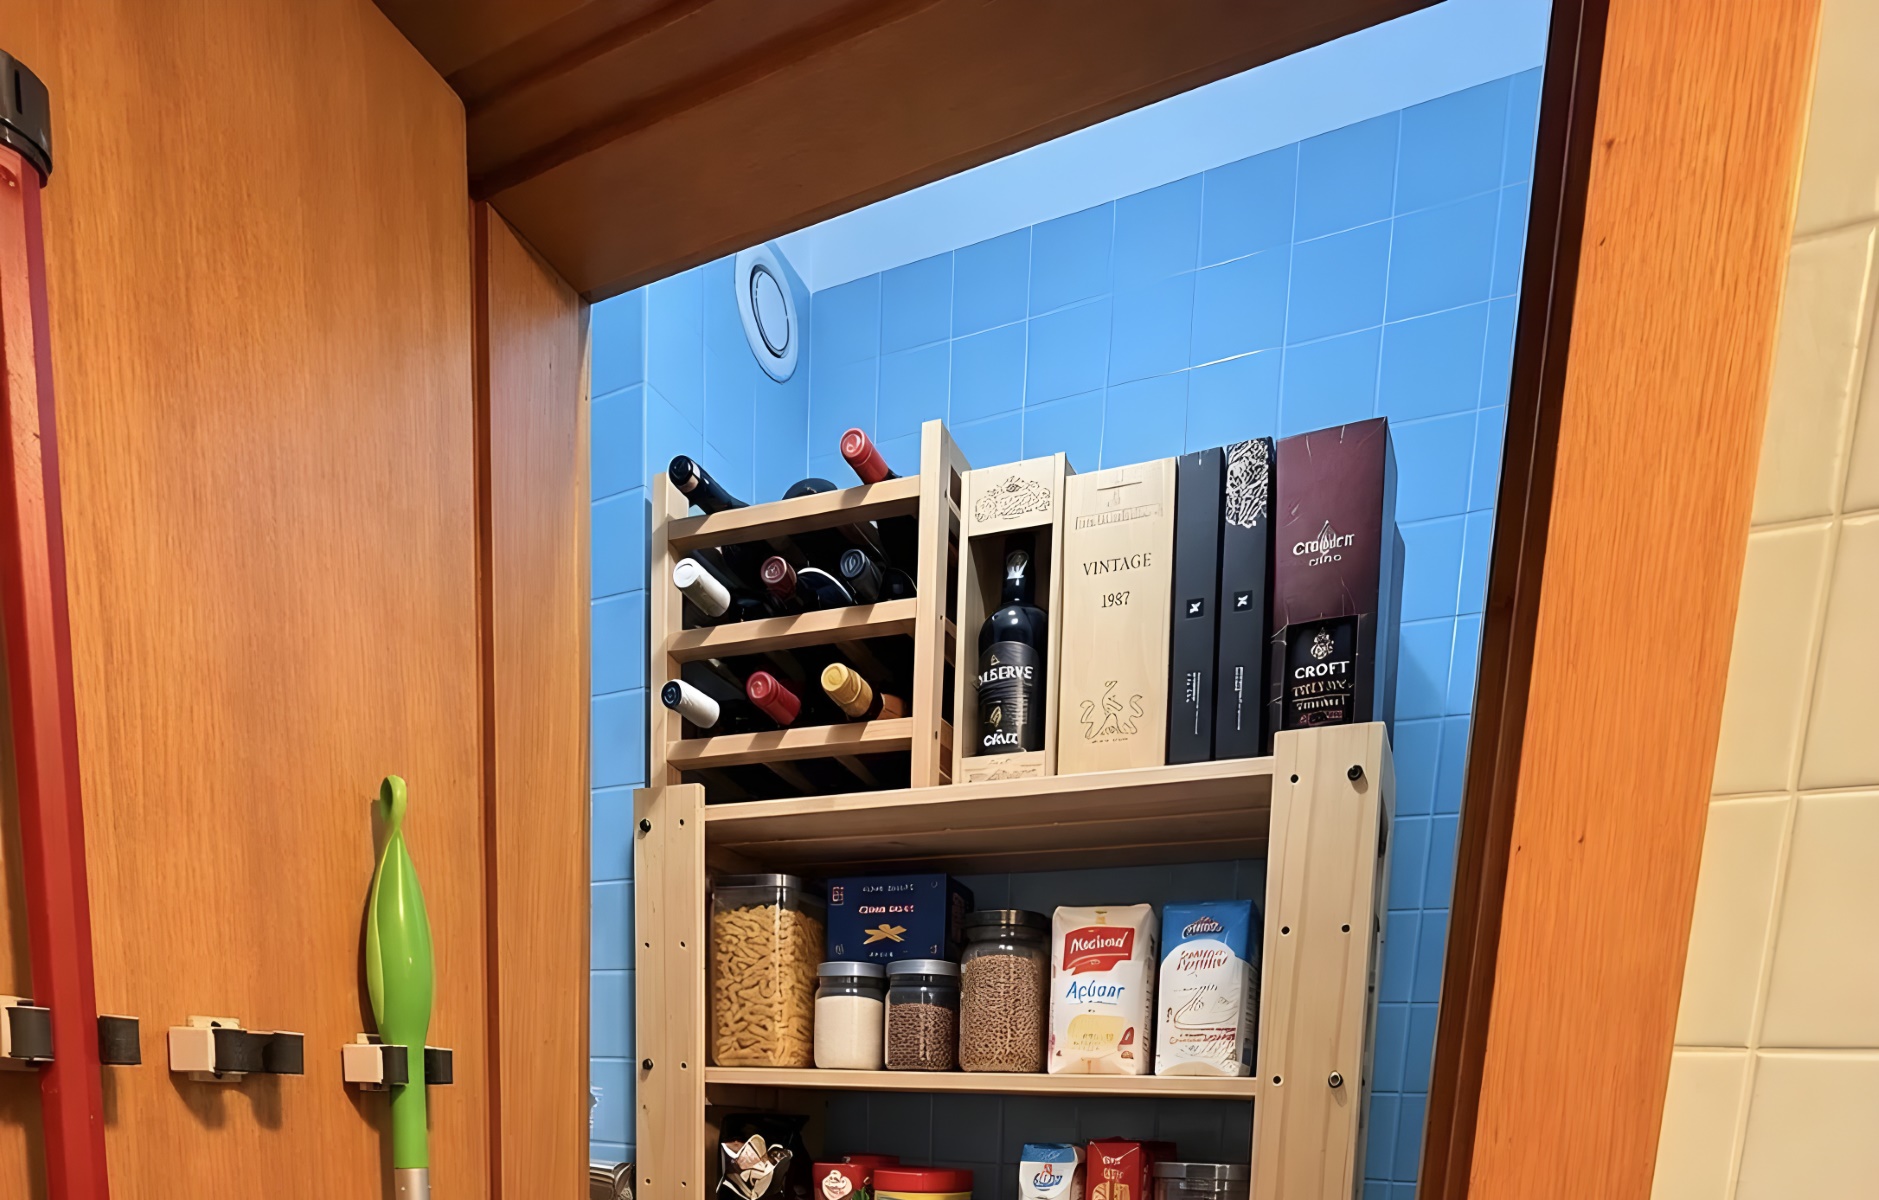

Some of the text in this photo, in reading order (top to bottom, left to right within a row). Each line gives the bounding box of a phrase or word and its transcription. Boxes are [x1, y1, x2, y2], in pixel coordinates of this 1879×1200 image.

[1083, 552, 1152, 576] VINTAGE
[1101, 591, 1130, 608] 1987
[1294, 660, 1350, 679] CROFT
